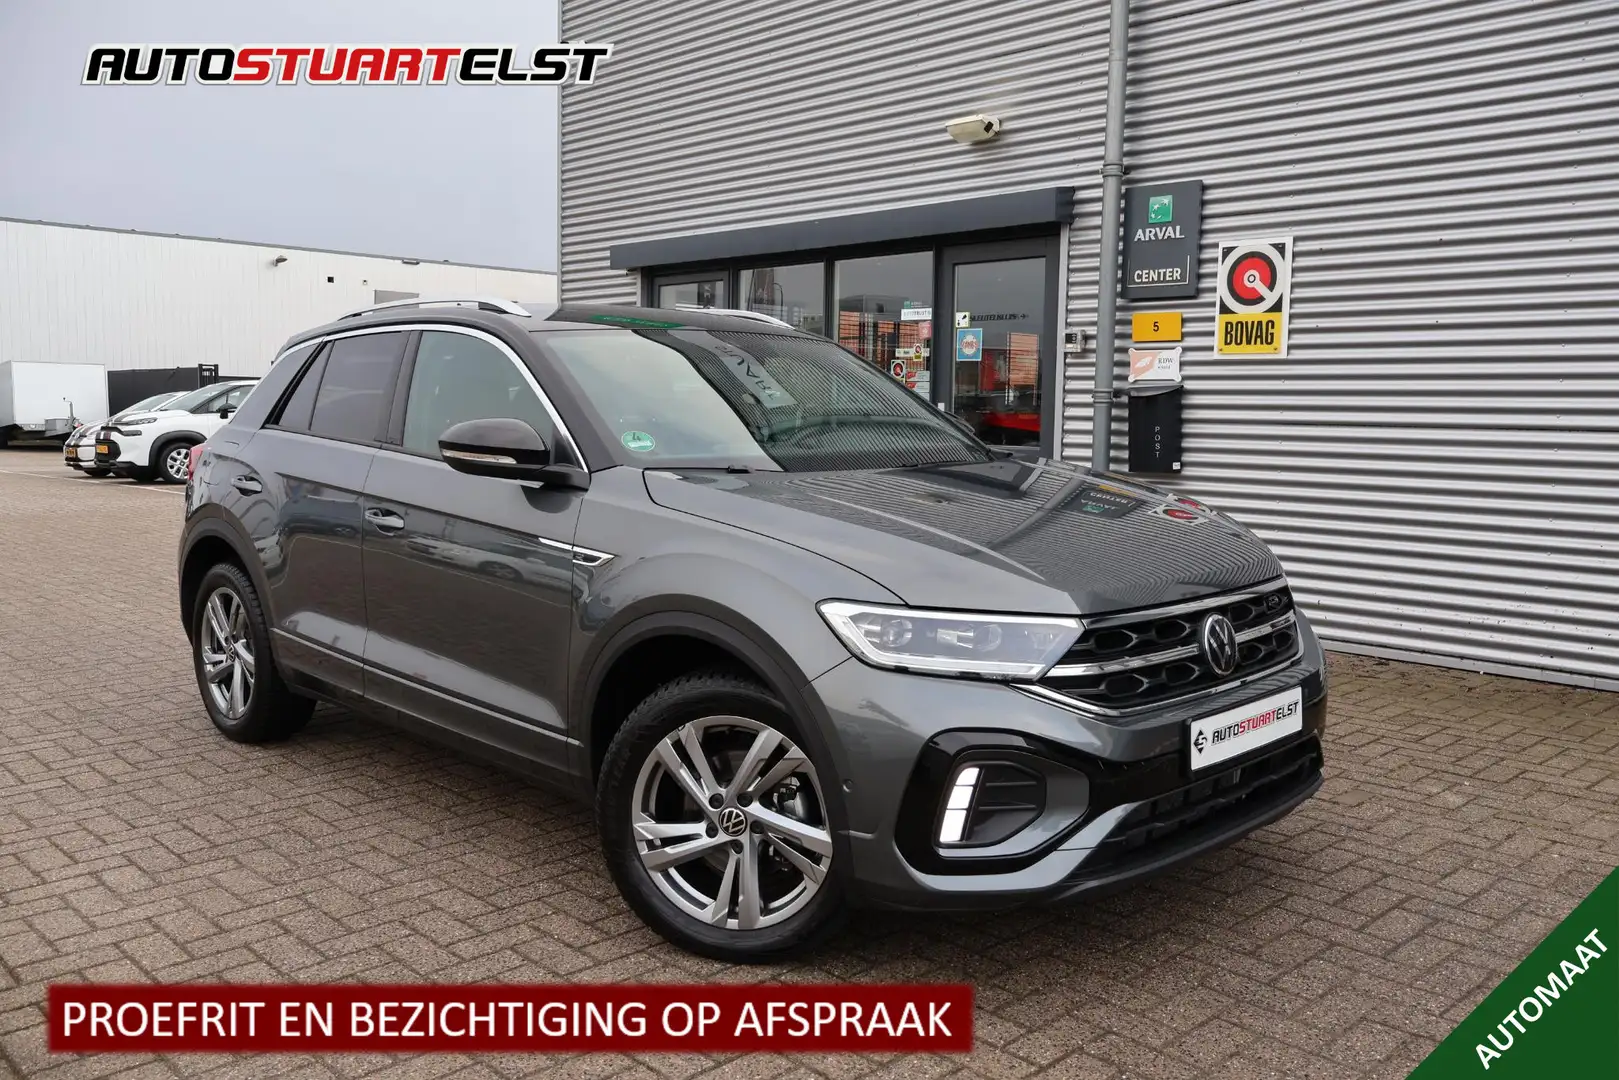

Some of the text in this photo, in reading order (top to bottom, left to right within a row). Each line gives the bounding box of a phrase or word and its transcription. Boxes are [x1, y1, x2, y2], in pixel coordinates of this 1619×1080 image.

[1134, 225, 1185, 242] ARVAL
[1134, 267, 1181, 283] CENTER
[1153, 321, 1160, 332] 5
[1224, 319, 1275, 346] BOVAG
[1212, 701, 1299, 744] AUTOSTUARTELST
